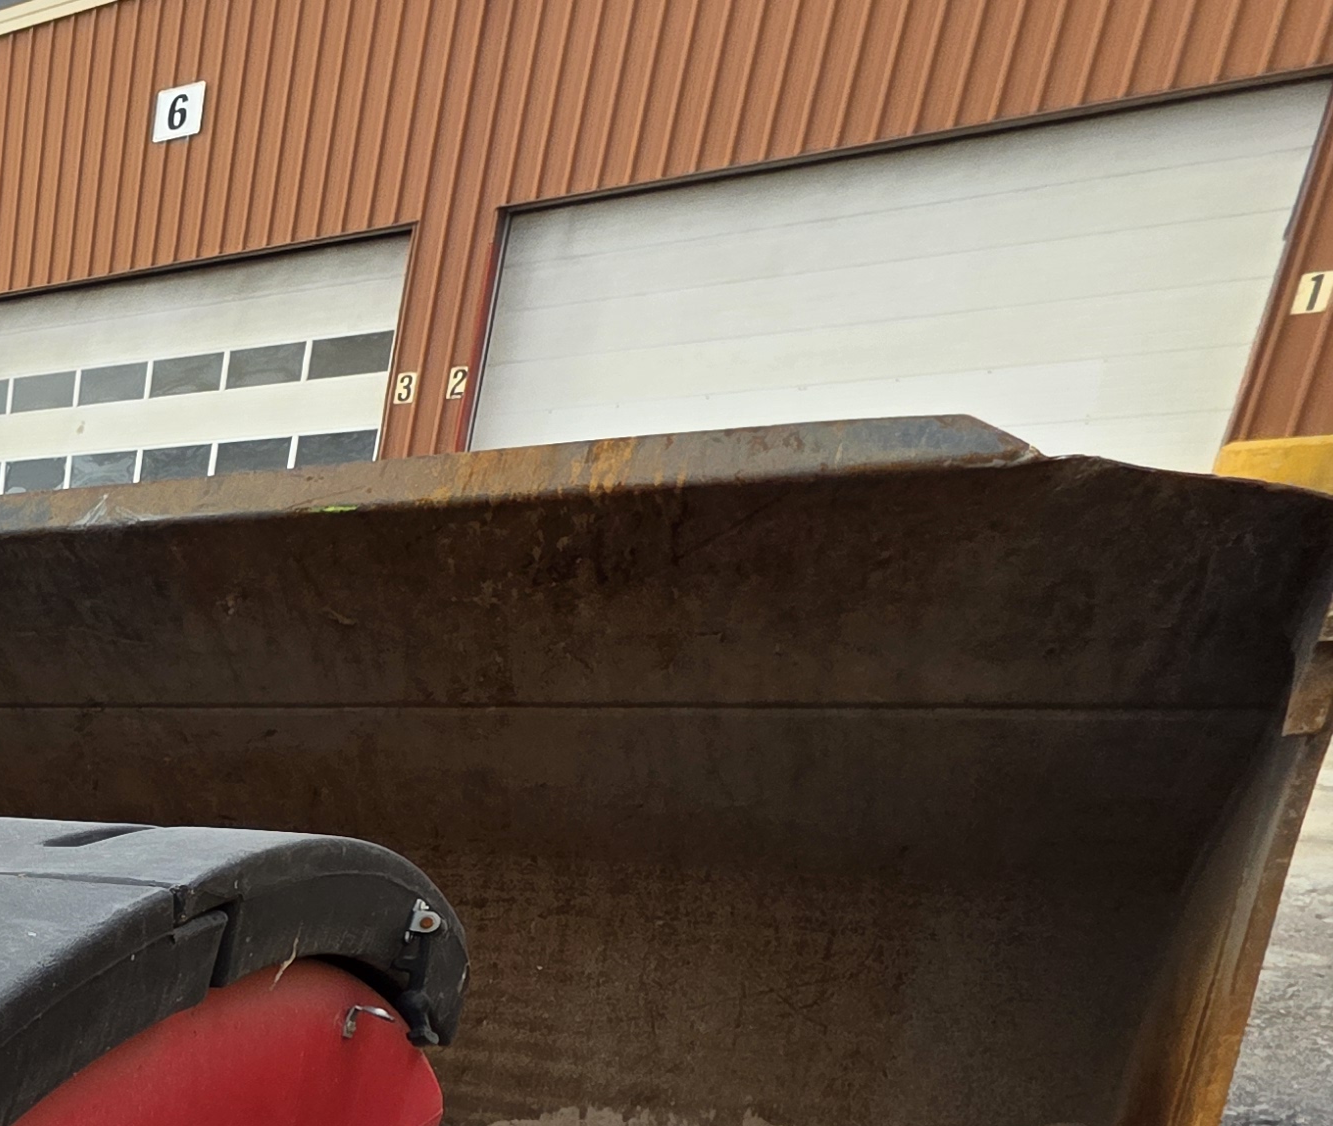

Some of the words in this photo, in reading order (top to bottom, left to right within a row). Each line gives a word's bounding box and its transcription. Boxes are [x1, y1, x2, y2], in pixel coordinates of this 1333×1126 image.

[167, 93, 189, 131] 6
[1305, 273, 1326, 312] 1
[397, 374, 413, 402] 3
[449, 368, 468, 396] 2
